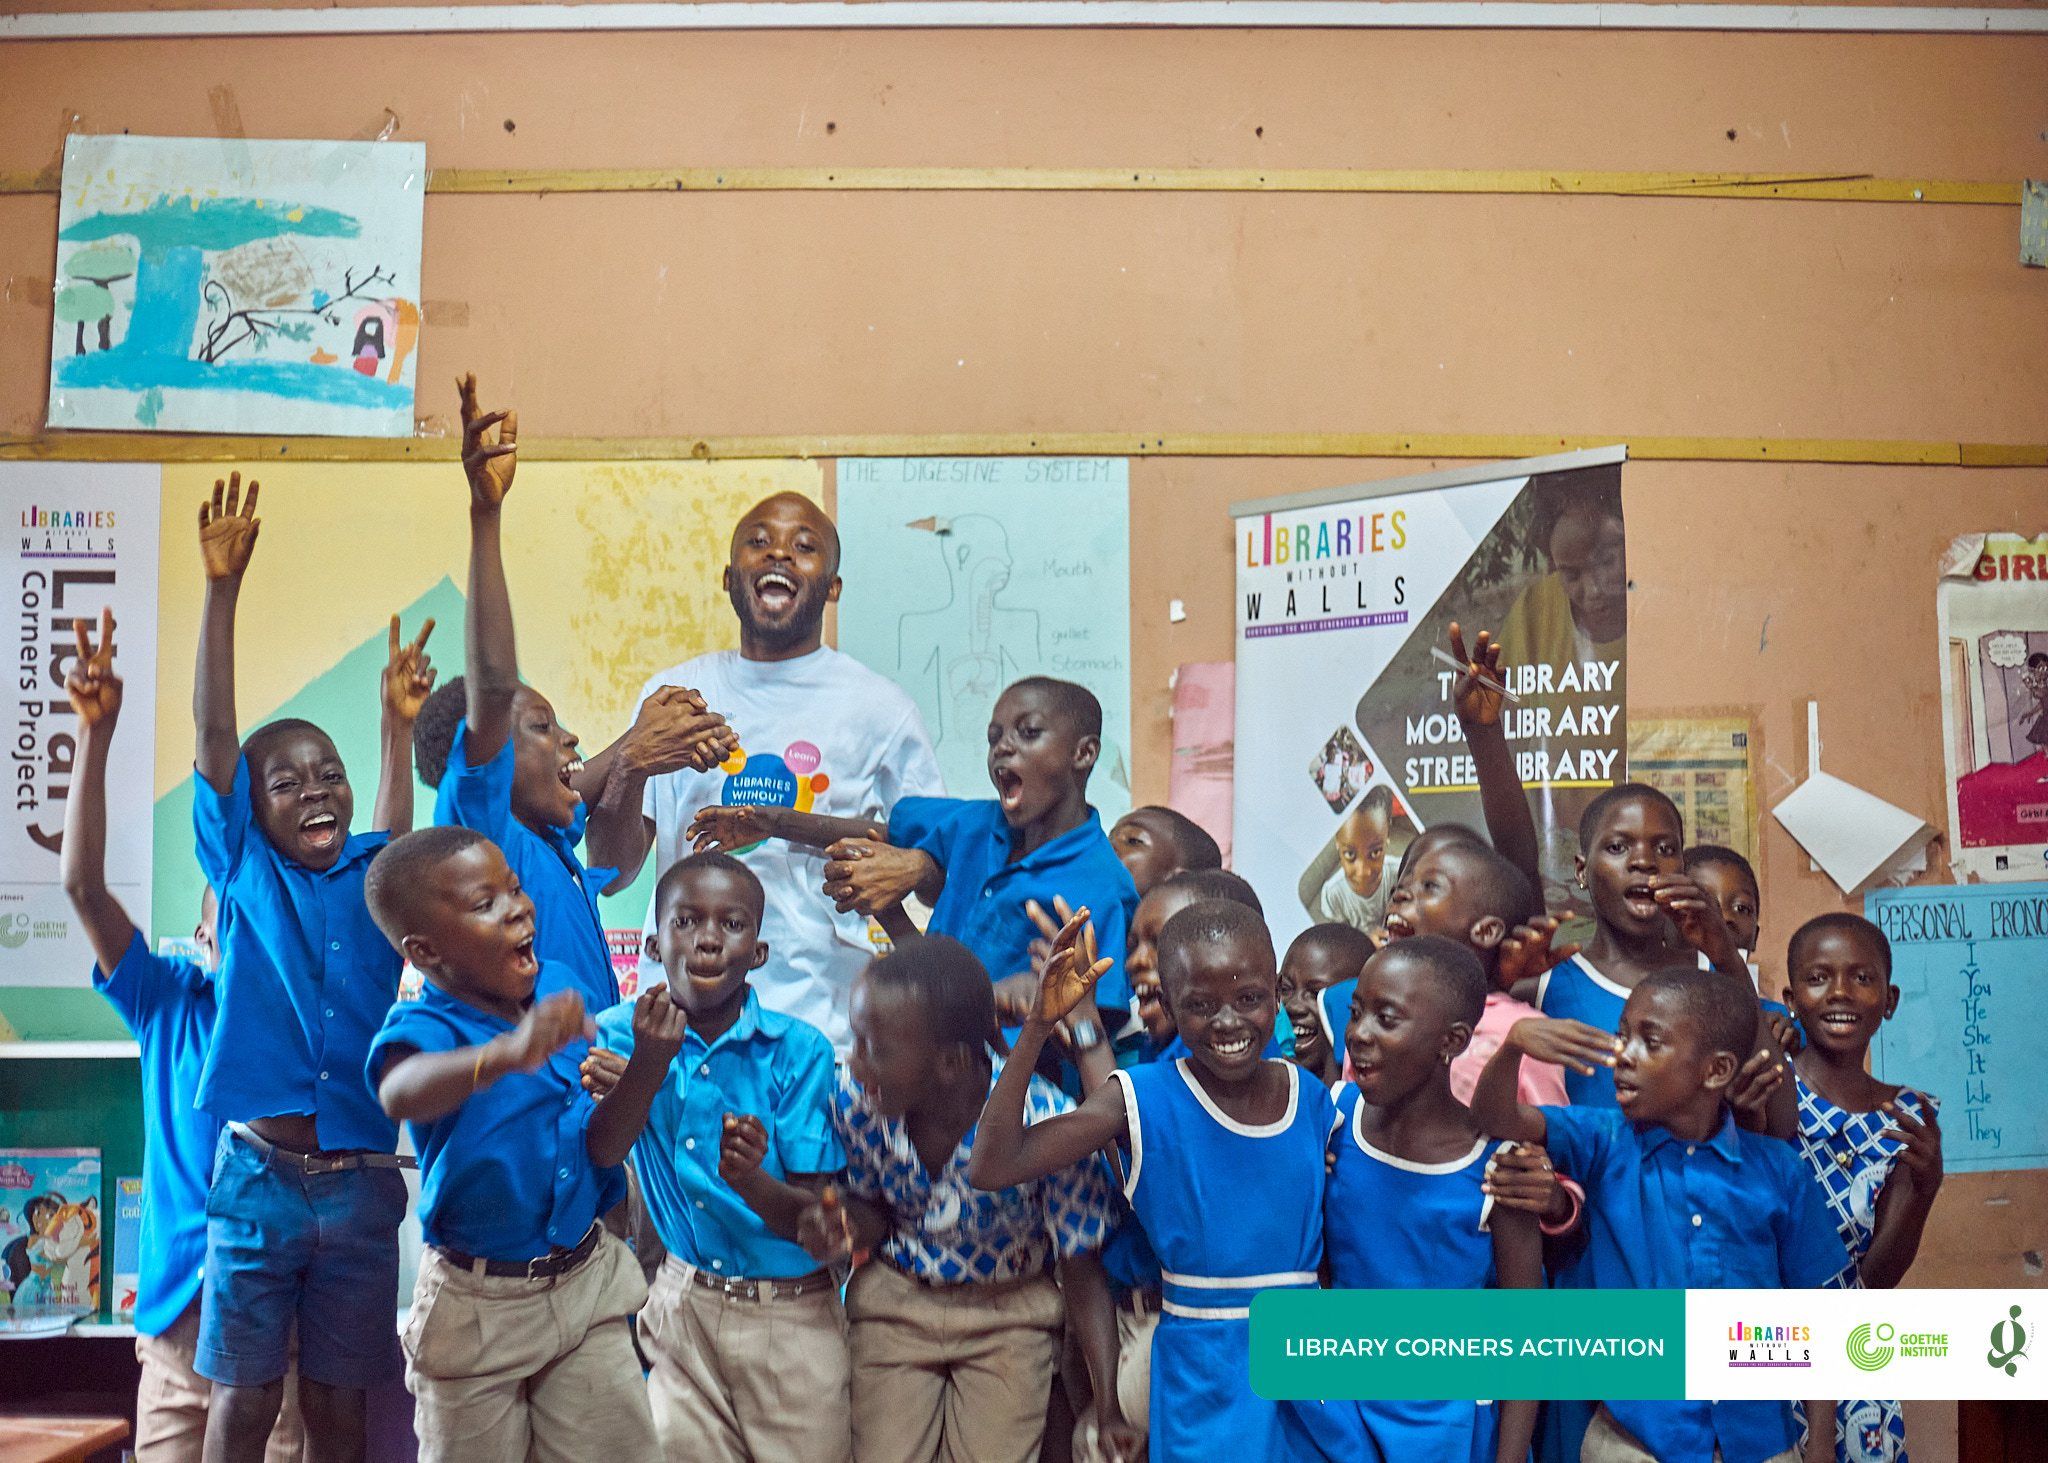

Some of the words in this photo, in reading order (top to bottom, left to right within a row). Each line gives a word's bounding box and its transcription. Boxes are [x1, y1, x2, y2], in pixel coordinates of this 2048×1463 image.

[843, 461, 881, 482] THE
[1025, 460, 1111, 482] SYSTEM
[22, 505, 115, 528] LIBRARIES
[21, 537, 115, 551] WALLS
[1247, 510, 1407, 567] LIBRARIES
[1042, 559, 1093, 578] Mouth
[1287, 562, 1358, 582] WITHOUT
[1247, 576, 1405, 620] WALLS
[20, 570, 46, 690] Corners
[1051, 654, 1123, 672] Stomach
[1505, 660, 1620, 696] LIBRARY
[1406, 713, 1468, 746] MOB
[1503, 704, 1620, 740] LIBRARY
[11, 701, 43, 810] Project
[788, 749, 817, 764] Learn
[1405, 753, 1480, 788] STREE
[1515, 748, 1619, 782] IBRARY
[732, 789, 785, 804] WITHOUT
[733, 776, 791, 792] LIBRARIES
[1878, 901, 1972, 942] PERSONAL
[1966, 943, 1978, 966] I
[1960, 969, 1991, 998] You
[1962, 998, 1987, 1024] He
[1962, 1024, 1992, 1048] She
[1966, 1048, 1986, 1076] It
[1966, 1079, 1992, 1105] We
[1964, 1107, 2002, 1149] They
